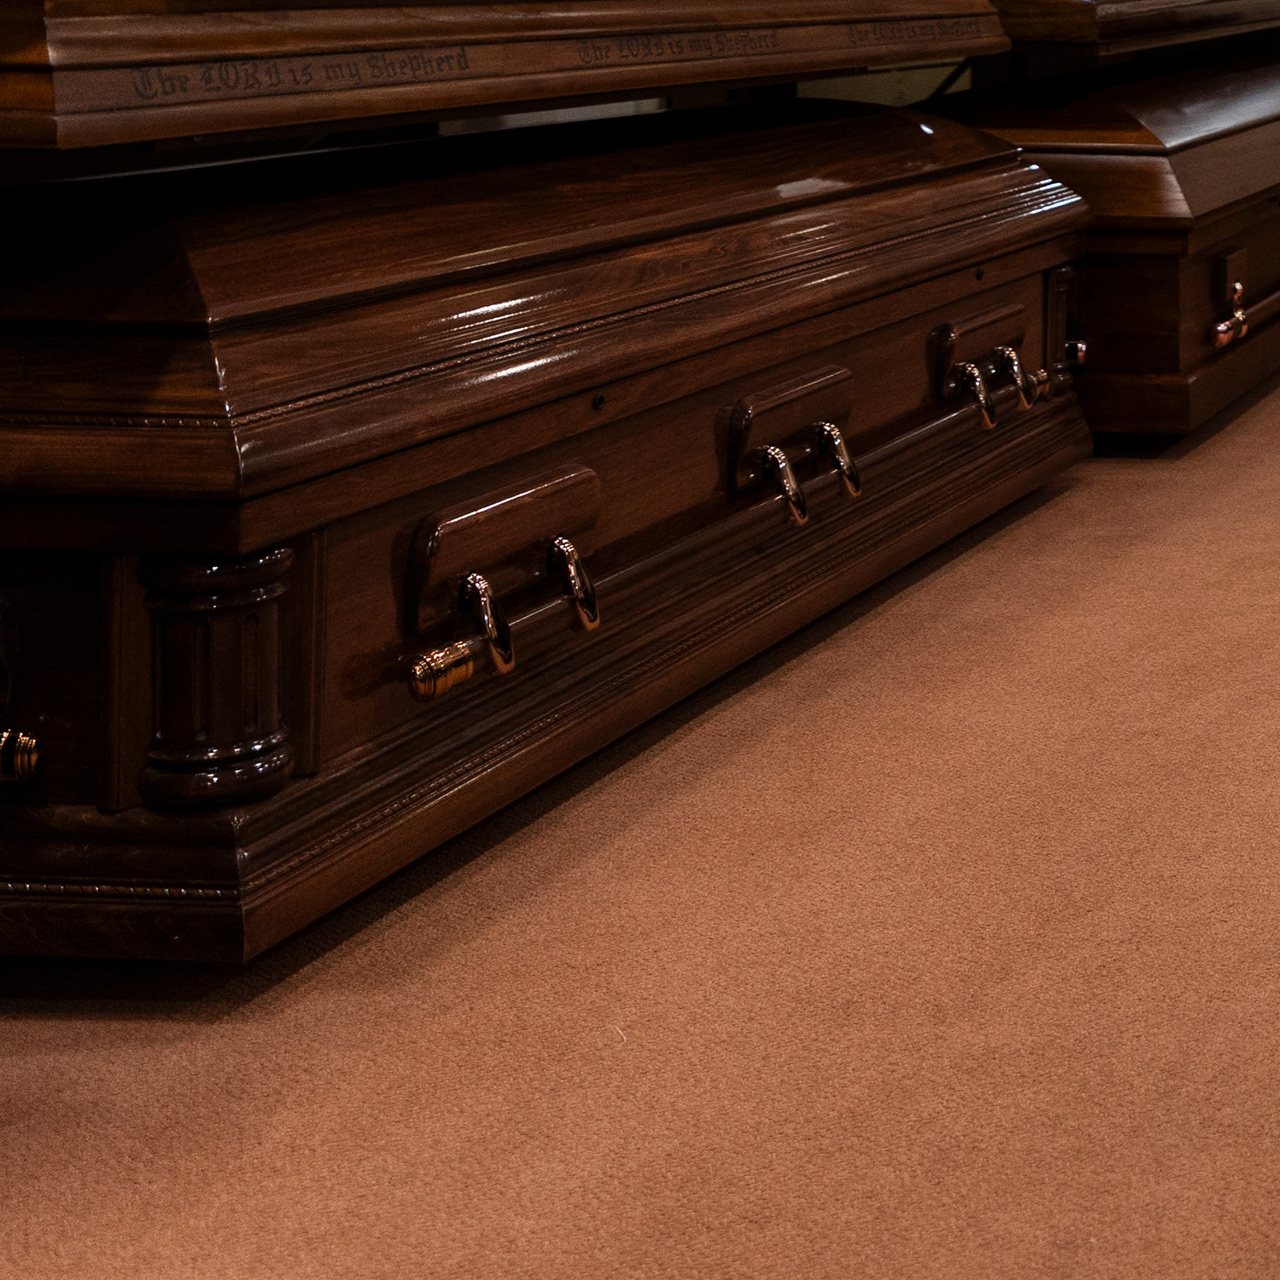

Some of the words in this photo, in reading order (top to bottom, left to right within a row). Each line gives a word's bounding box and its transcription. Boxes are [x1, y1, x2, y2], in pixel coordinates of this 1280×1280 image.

[575, 38, 610, 65] The
[668, 34, 685, 55] is
[131, 66, 189, 101] The
[198, 59, 282, 93] LORD
[288, 60, 314, 86] is
[322, 61, 362, 86] my
[366, 46, 470, 81] Shepherd
